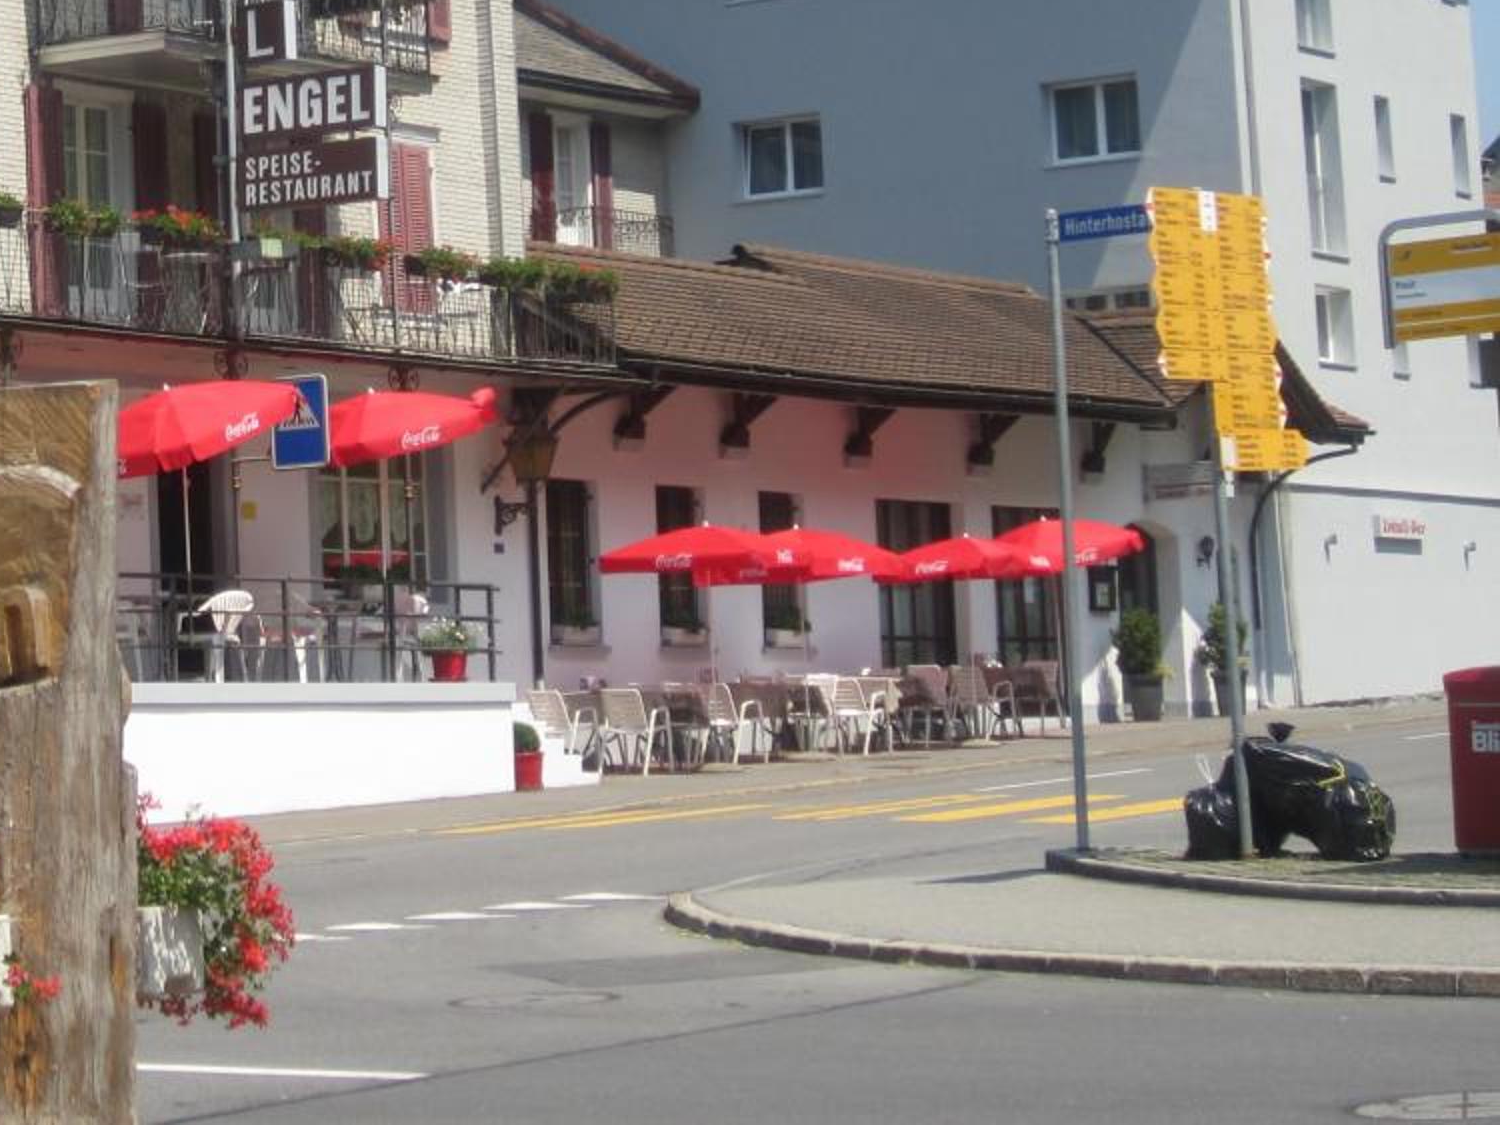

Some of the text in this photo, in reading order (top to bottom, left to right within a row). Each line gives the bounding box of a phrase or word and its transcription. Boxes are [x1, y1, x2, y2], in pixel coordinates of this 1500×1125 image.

[243, 74, 371, 135] ENGEL
[245, 150, 322, 180] SPEISE-
[245, 170, 373, 207] RESTAURANT
[1064, 213, 1146, 236] Hinterhosta
